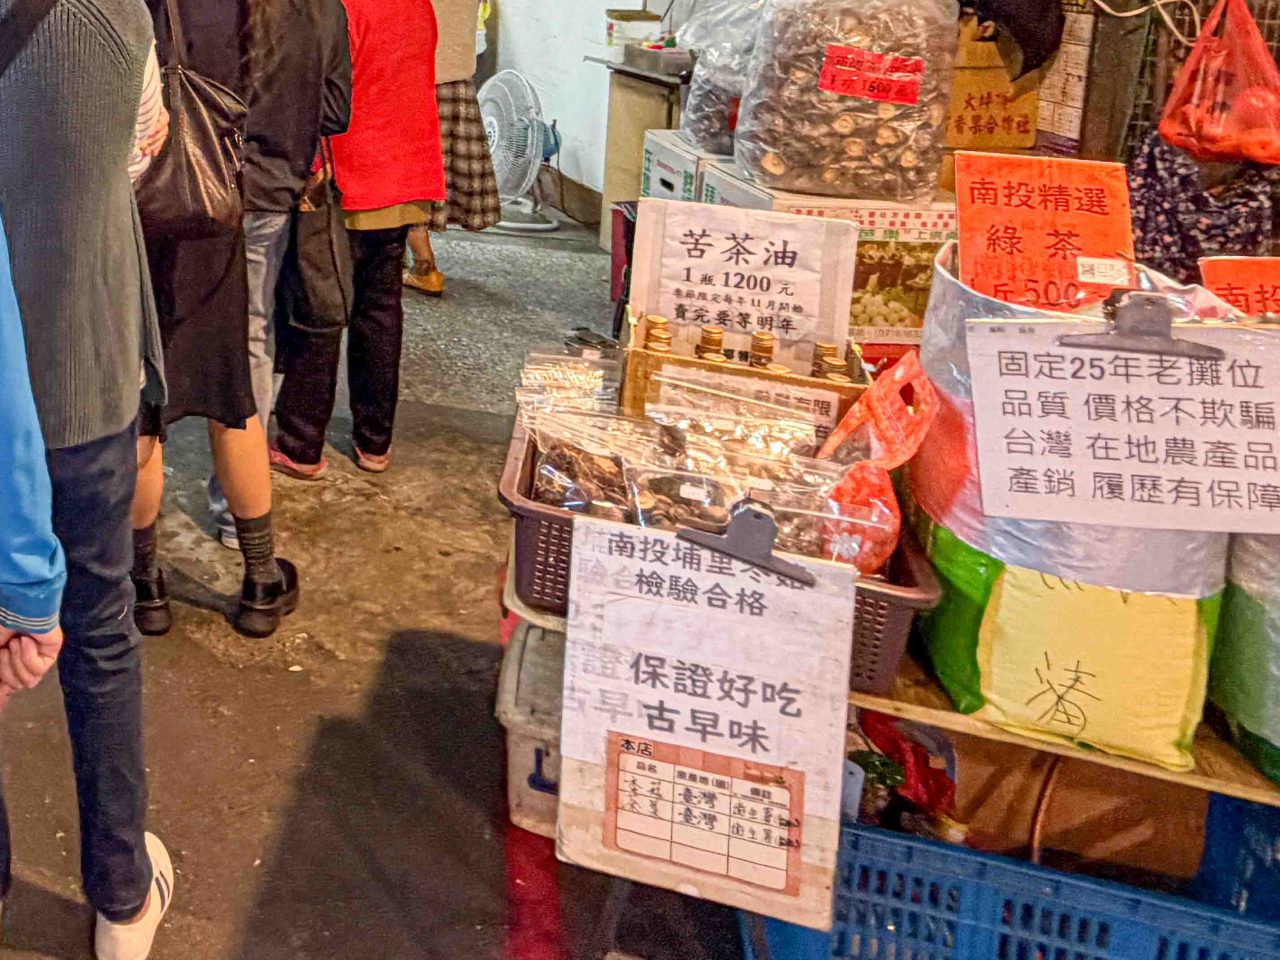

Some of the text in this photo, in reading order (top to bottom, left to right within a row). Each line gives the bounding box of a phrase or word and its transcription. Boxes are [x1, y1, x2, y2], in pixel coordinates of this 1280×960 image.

[969, 177, 1110, 216] 南投精選
[679, 228, 799, 269] 苦茶油
[985, 224, 1083, 261] 綠茶
[1083, 392, 1276, 431] 價格不欺騙
[1086, 431, 1279, 472] 在地農產品
[635, 568, 768, 617] 檢驗合格
[629, 652, 803, 719] 保證好吃
[643, 699, 771, 754] 古早味
[620, 738, 653, 757] 本店
